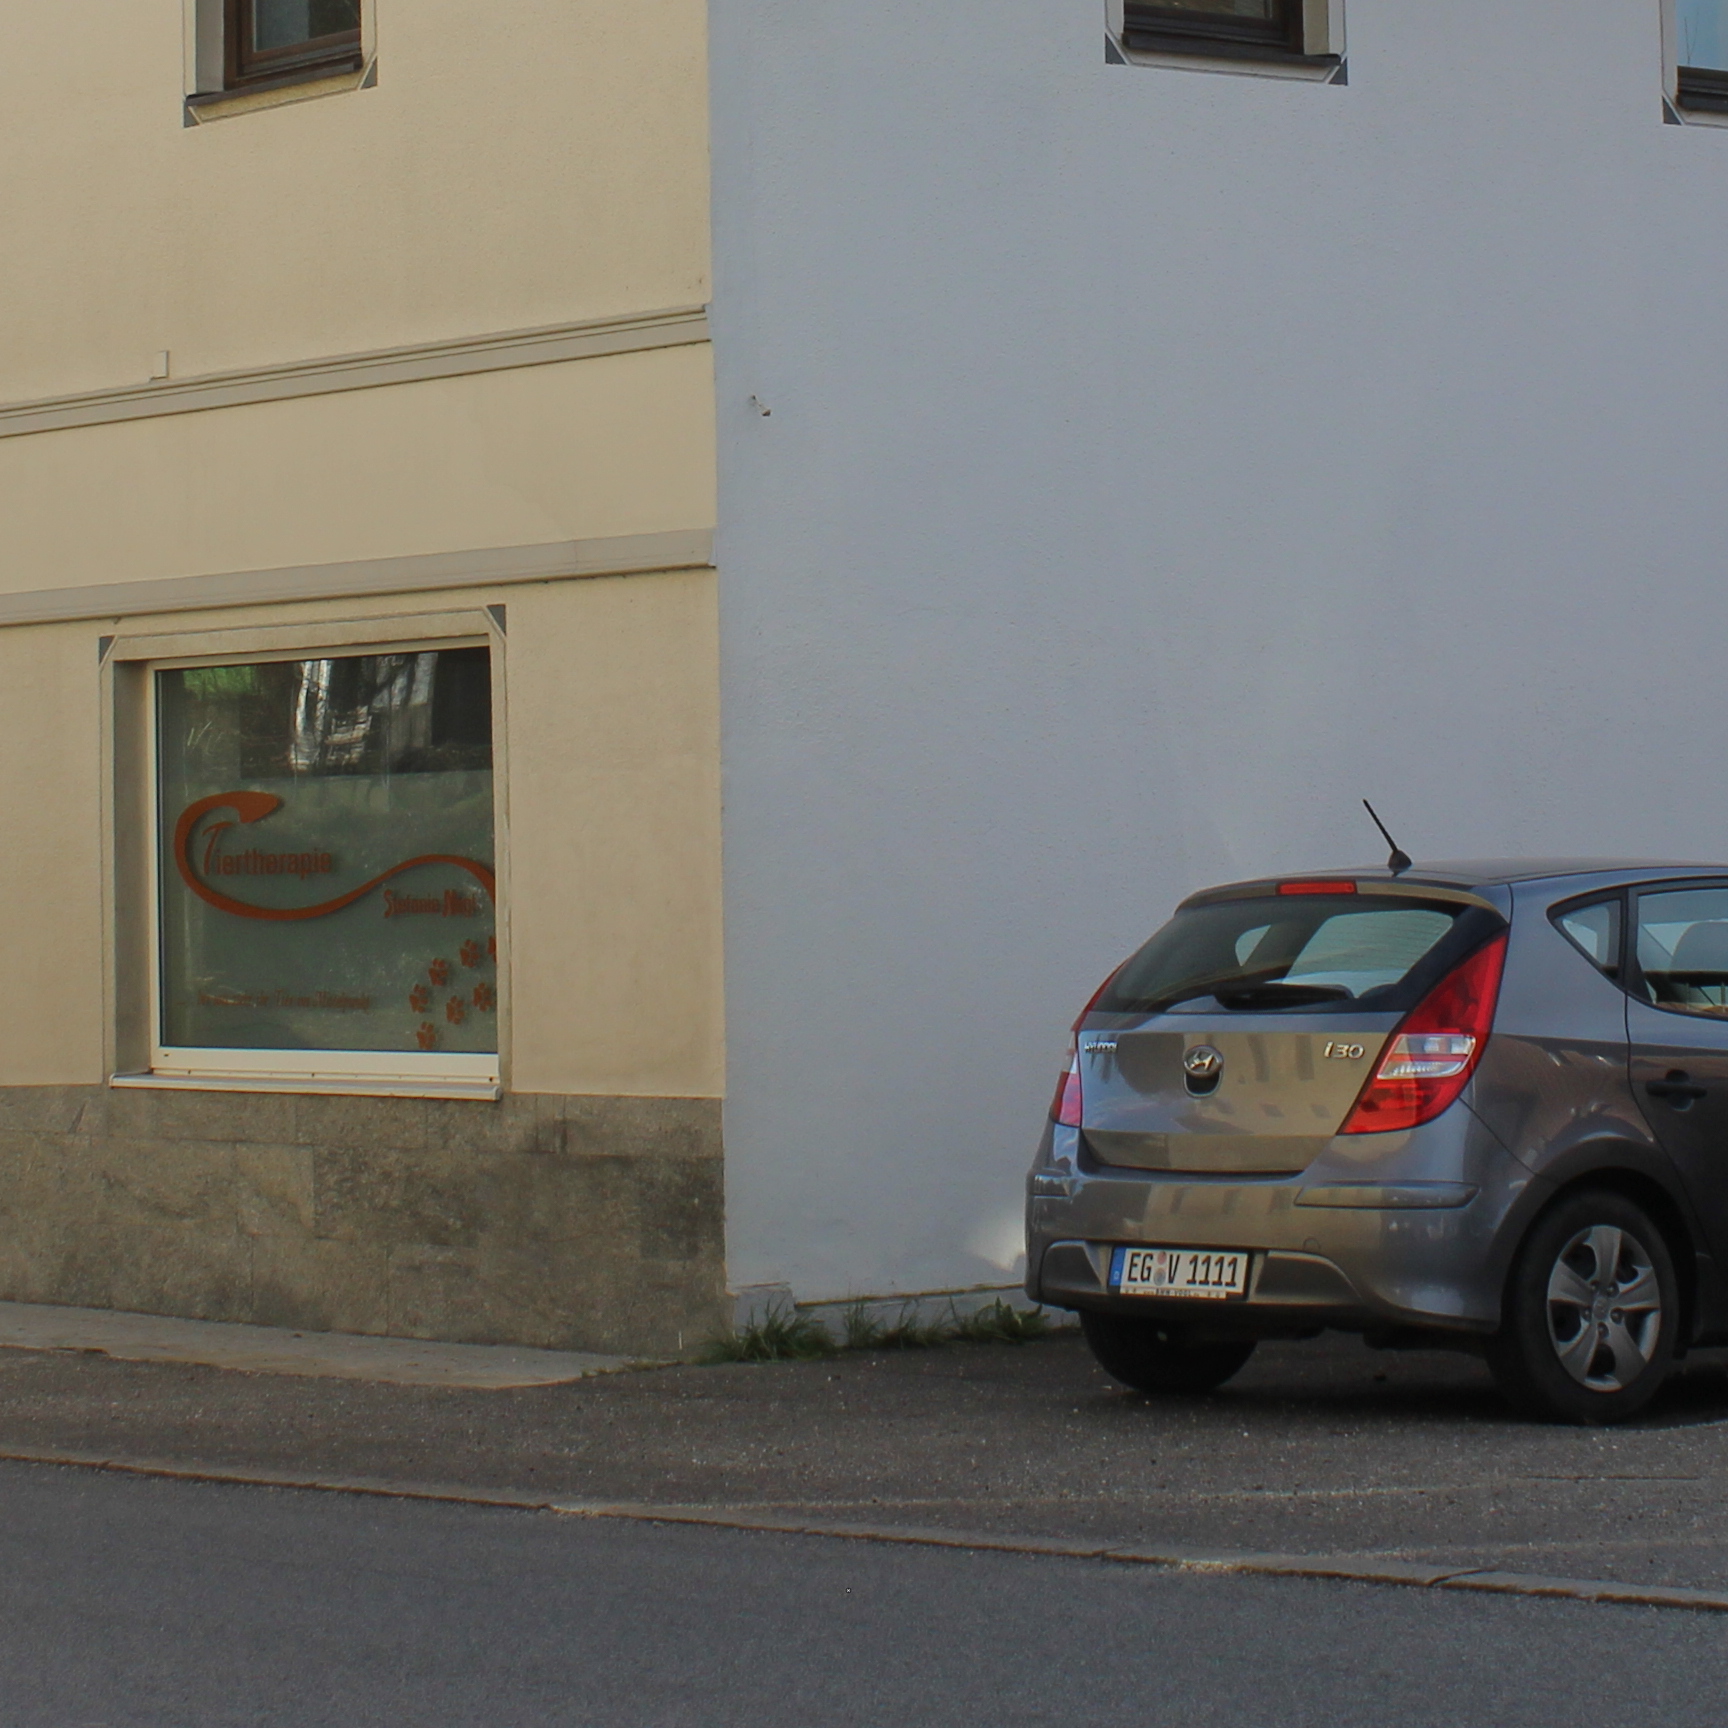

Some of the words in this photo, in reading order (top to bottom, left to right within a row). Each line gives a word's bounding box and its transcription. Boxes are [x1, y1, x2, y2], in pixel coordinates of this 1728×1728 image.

[202, 821, 333, 880] Tiertherapie
[1127, 1252, 1154, 1282] EG
[1167, 1254, 1180, 1284] V
[1186, 1254, 1238, 1287] 1111
